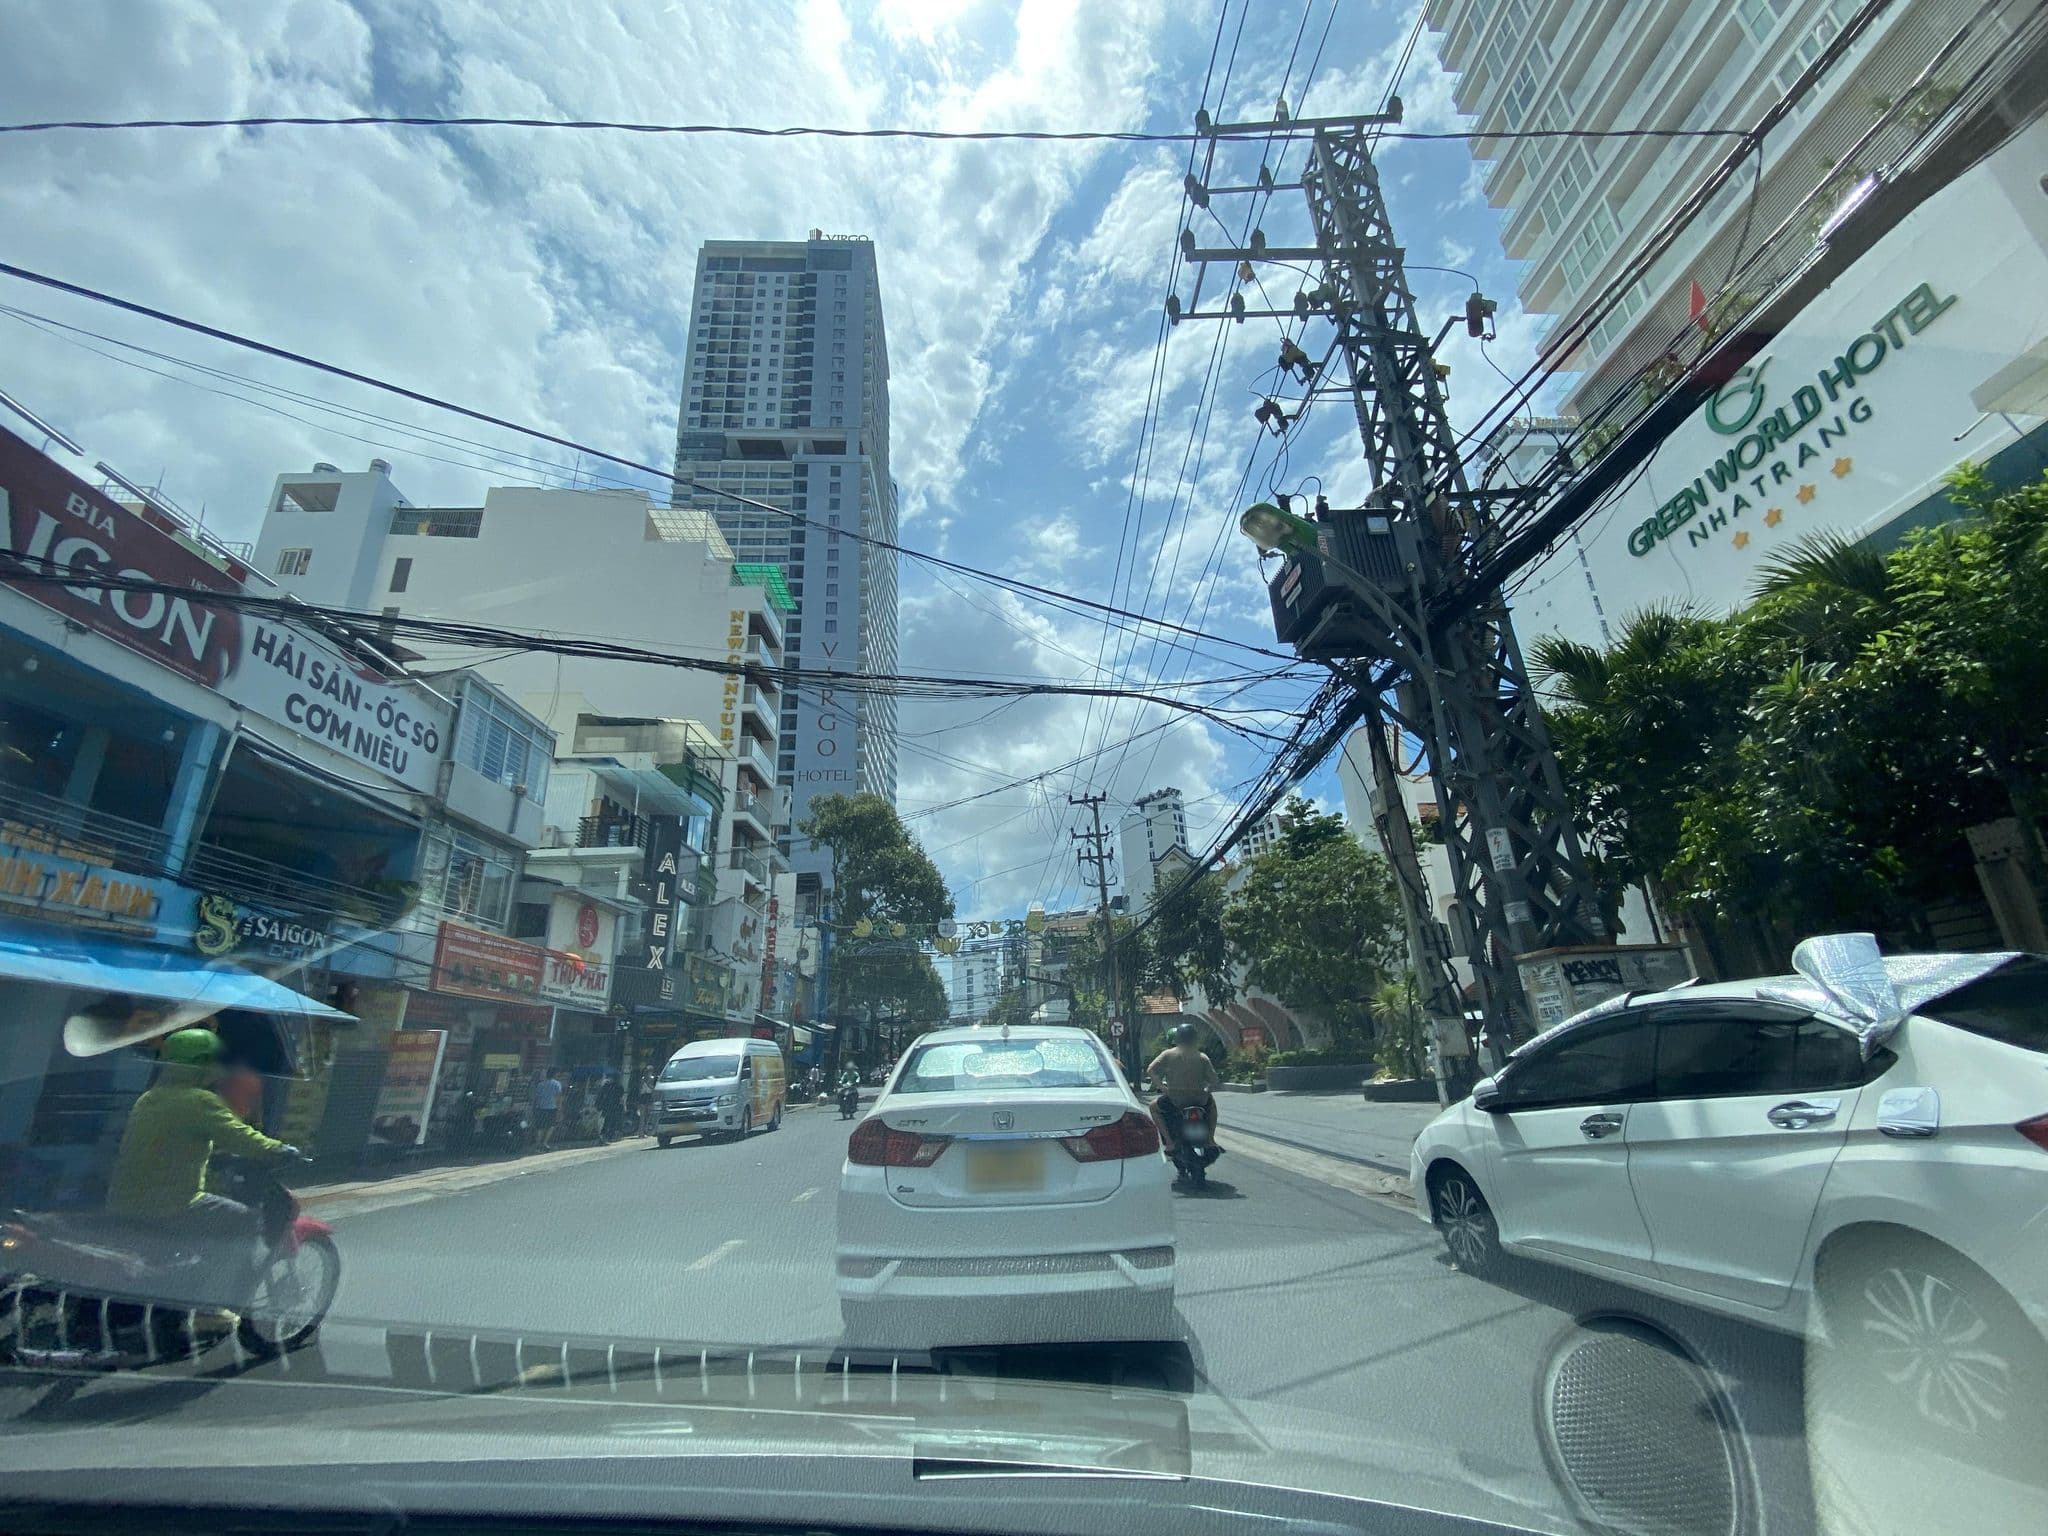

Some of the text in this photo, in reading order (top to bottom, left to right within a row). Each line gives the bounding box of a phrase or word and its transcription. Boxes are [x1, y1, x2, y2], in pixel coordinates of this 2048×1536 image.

[1627, 282, 1959, 557] GREEN WORLD HOTEL
[66, 491, 116, 539] BIA
[727, 610, 744, 649] NEW
[252, 626, 306, 680] HẢI
[307, 660, 362, 712] SẢN
[376, 696, 410, 738] ỐC
[410, 722, 439, 754] SÒ
[817, 641, 839, 756] VIRGO
[285, 693, 408, 775] CƠM NIÊU
[798, 769, 853, 781] HOTEL
[255, 916, 327, 949] SAIGON
[648, 852, 677, 969] ALEX
